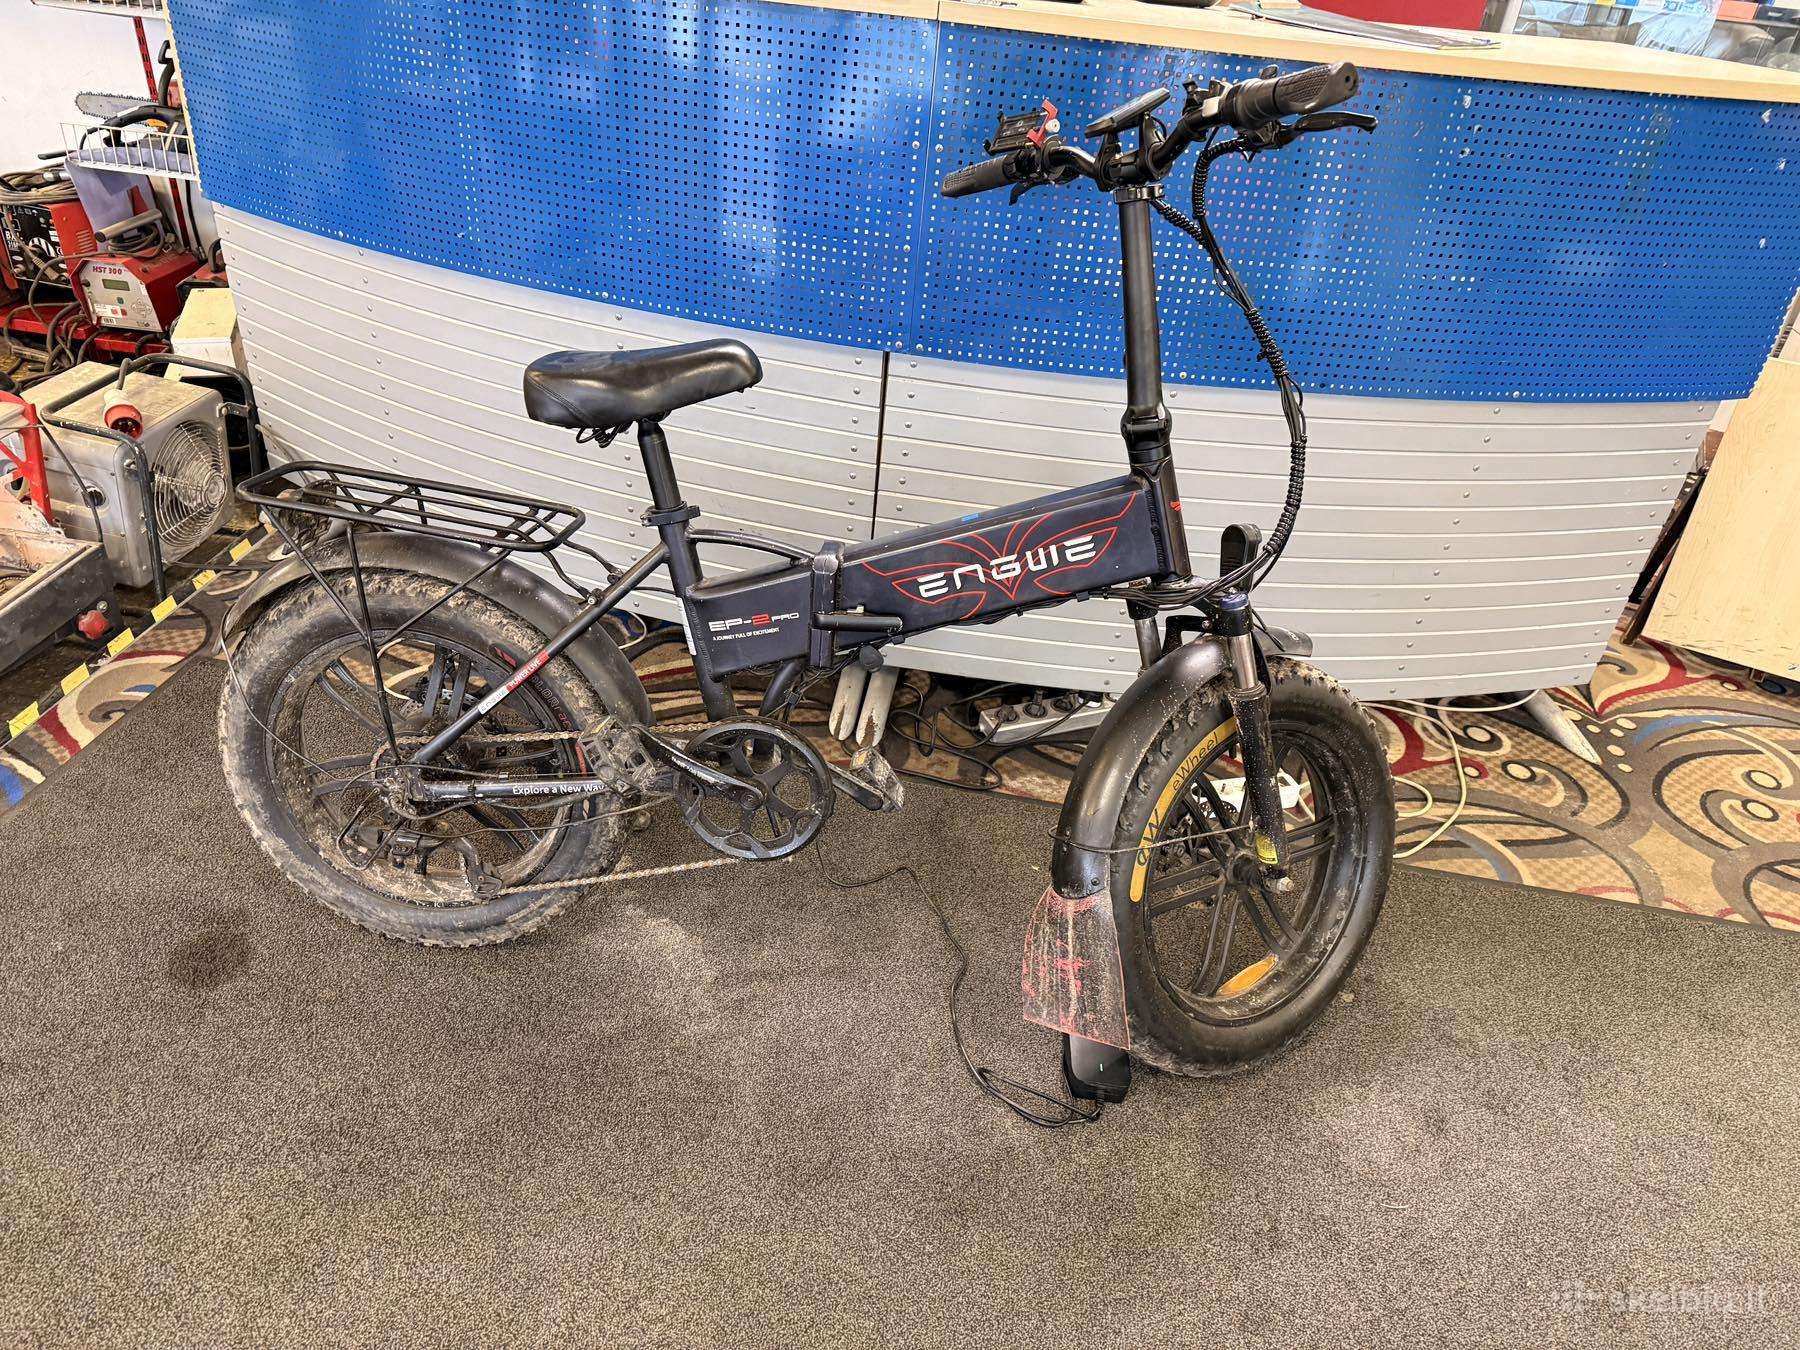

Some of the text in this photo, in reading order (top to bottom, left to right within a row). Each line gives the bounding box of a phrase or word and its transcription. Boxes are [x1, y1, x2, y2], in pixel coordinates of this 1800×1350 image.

[93, 265, 123, 275] HST 300
[771, 612, 800, 623] PRO
[512, 784, 551, 797] Explore
[552, 786, 559, 794] a
[559, 784, 582, 794] New
